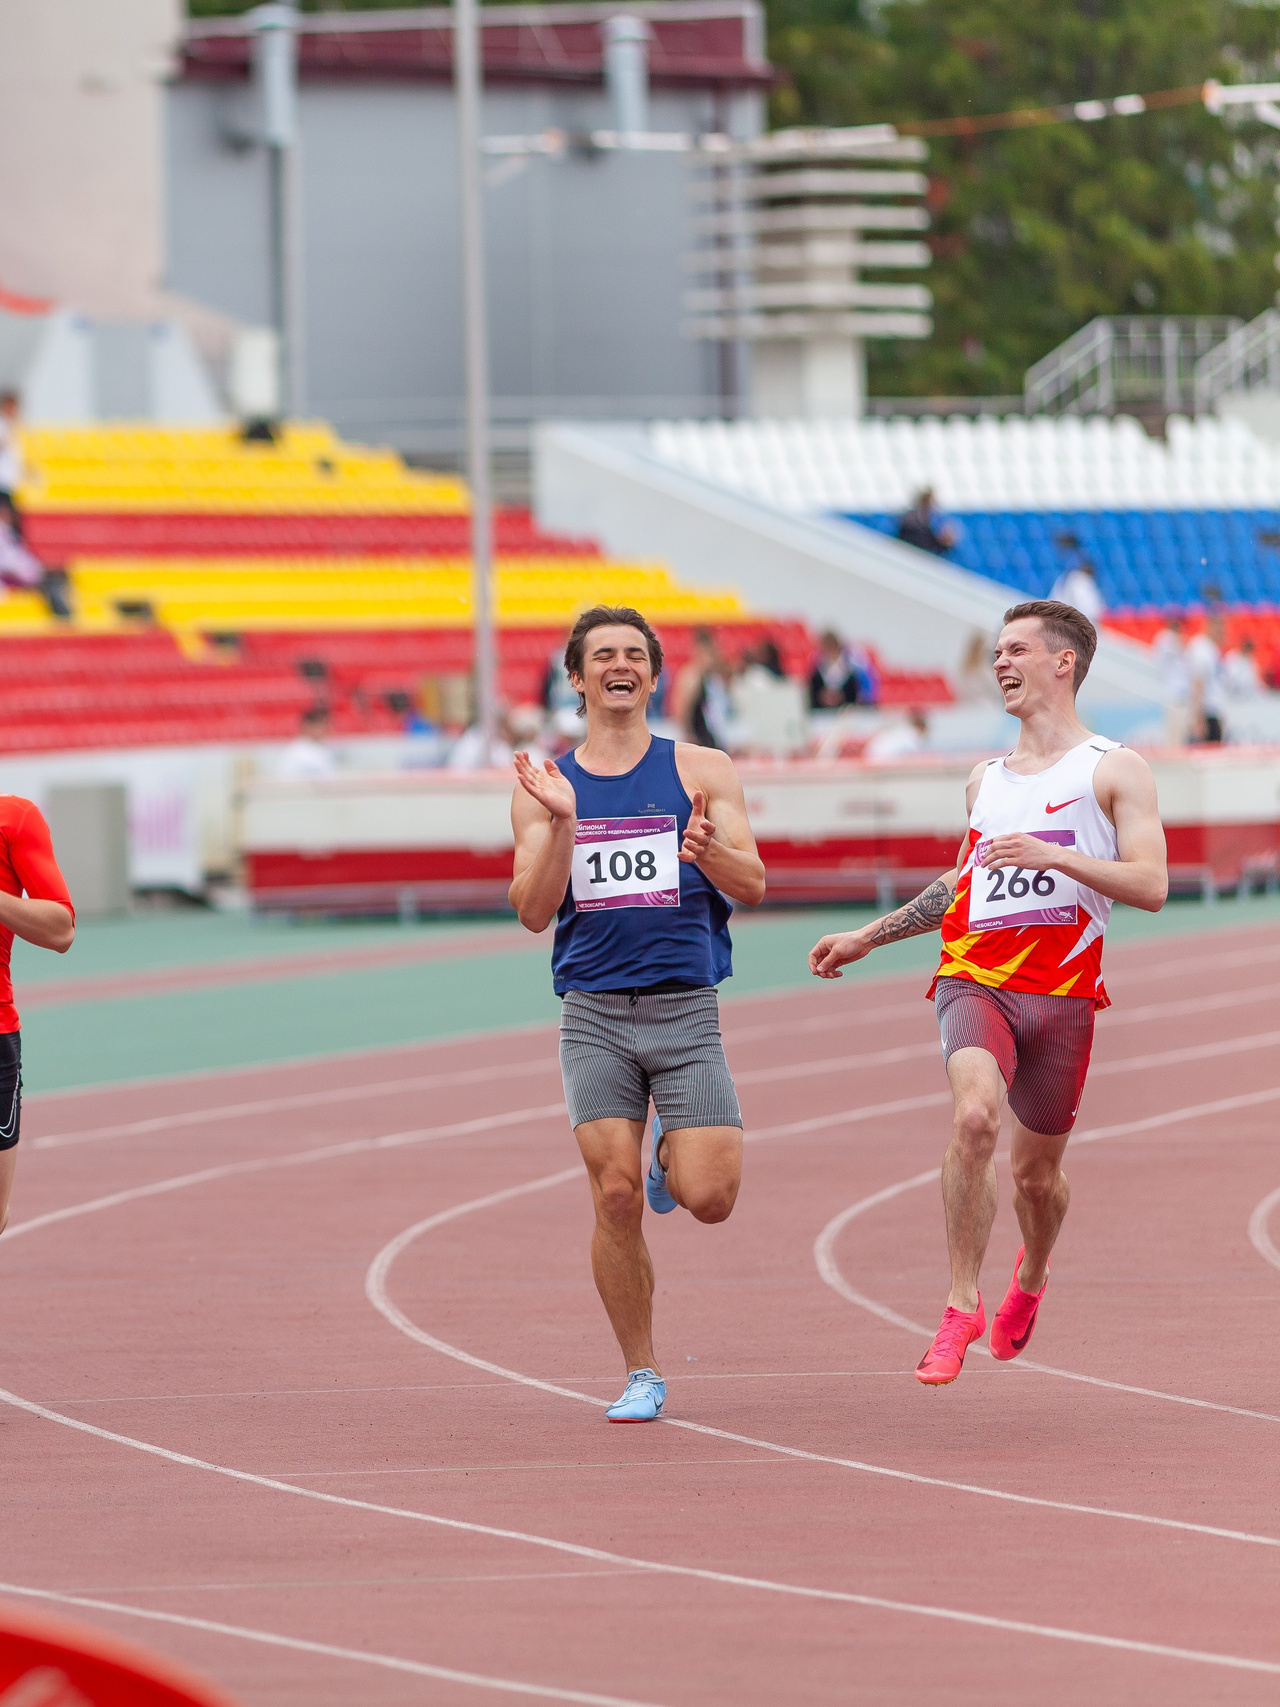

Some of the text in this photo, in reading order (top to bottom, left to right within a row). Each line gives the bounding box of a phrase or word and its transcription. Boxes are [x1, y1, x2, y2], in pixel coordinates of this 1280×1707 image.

[586, 850, 657, 884] 108
[986, 868, 1056, 903] 266
[974, 920, 1003, 929] ЧЕБОКСАРЫ
